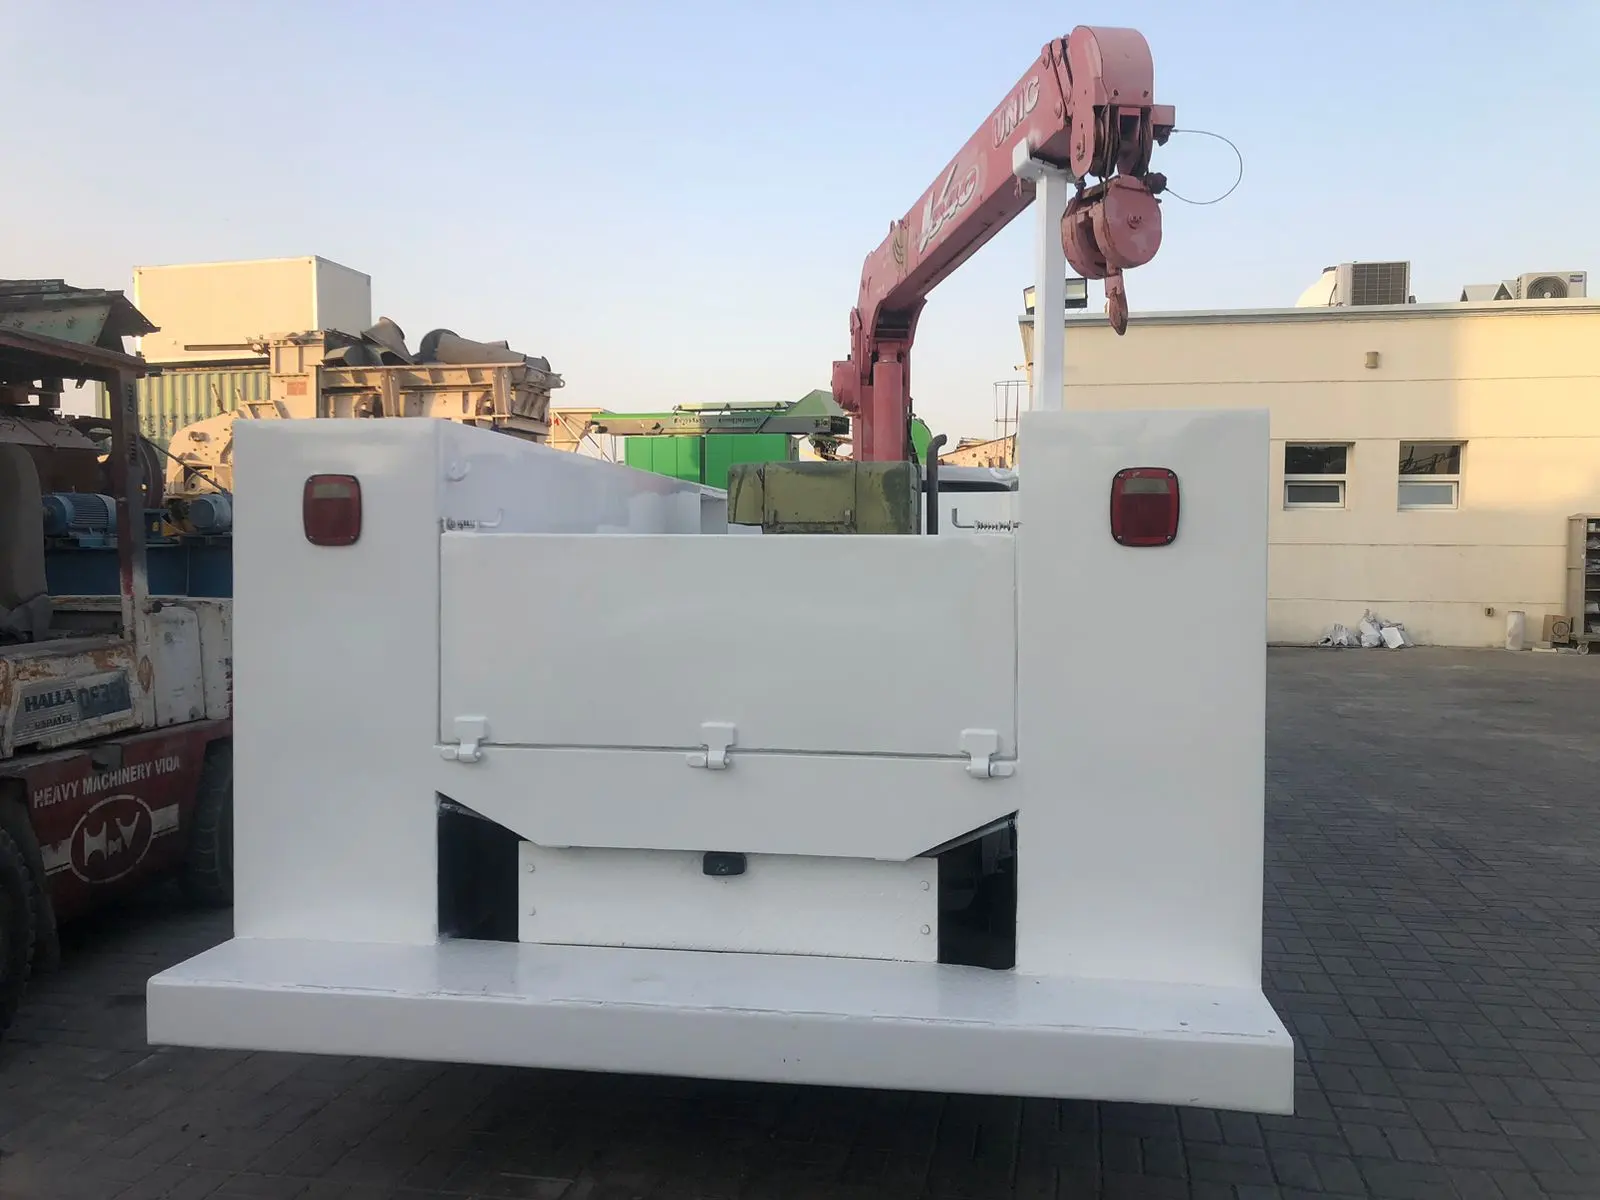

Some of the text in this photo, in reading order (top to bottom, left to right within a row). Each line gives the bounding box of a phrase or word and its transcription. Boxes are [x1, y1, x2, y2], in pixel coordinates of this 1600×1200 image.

[993, 75, 1040, 148] UNIC
[24, 688, 76, 712] HALLA
[33, 780, 79, 809] HEAVY
[82, 761, 153, 796] MACHINERY
